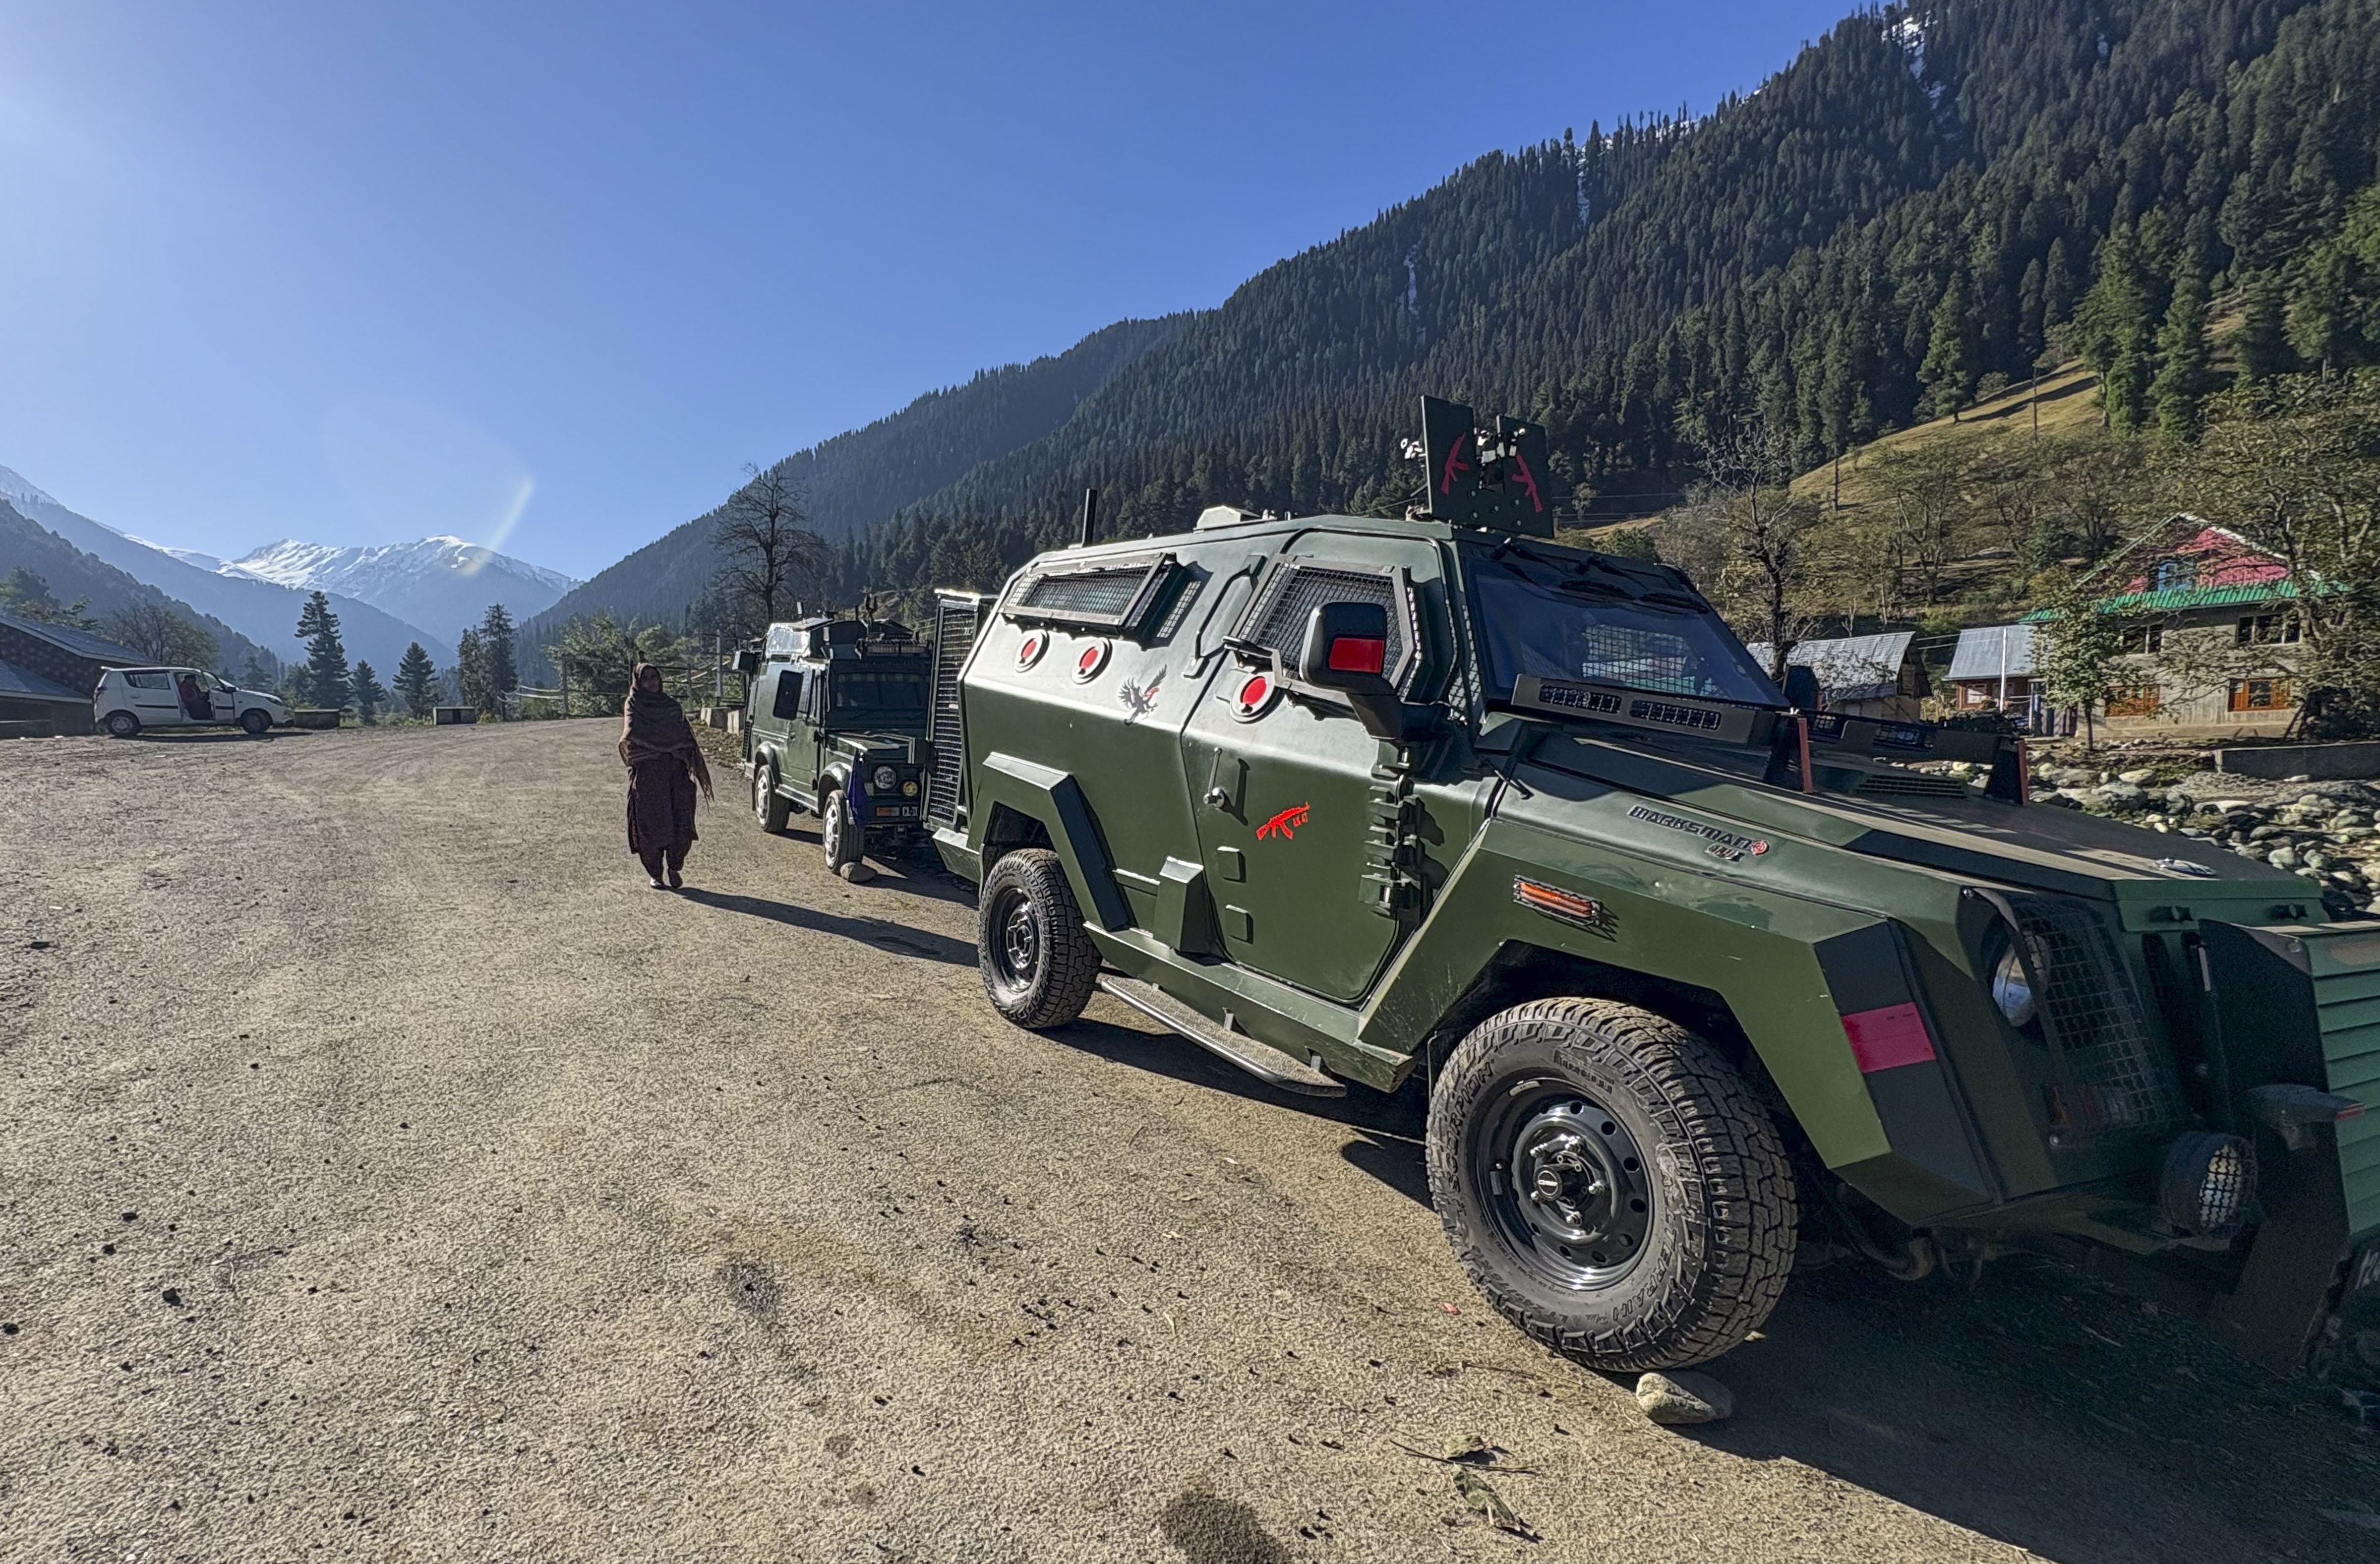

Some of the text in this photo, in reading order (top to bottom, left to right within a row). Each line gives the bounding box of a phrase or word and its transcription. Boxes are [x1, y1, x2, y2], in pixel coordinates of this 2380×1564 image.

[1628, 805, 1752, 849] MARKSMAN
[1445, 1061, 1493, 1193] SCORPION
[1612, 1227, 1676, 1322] TERRAIN
